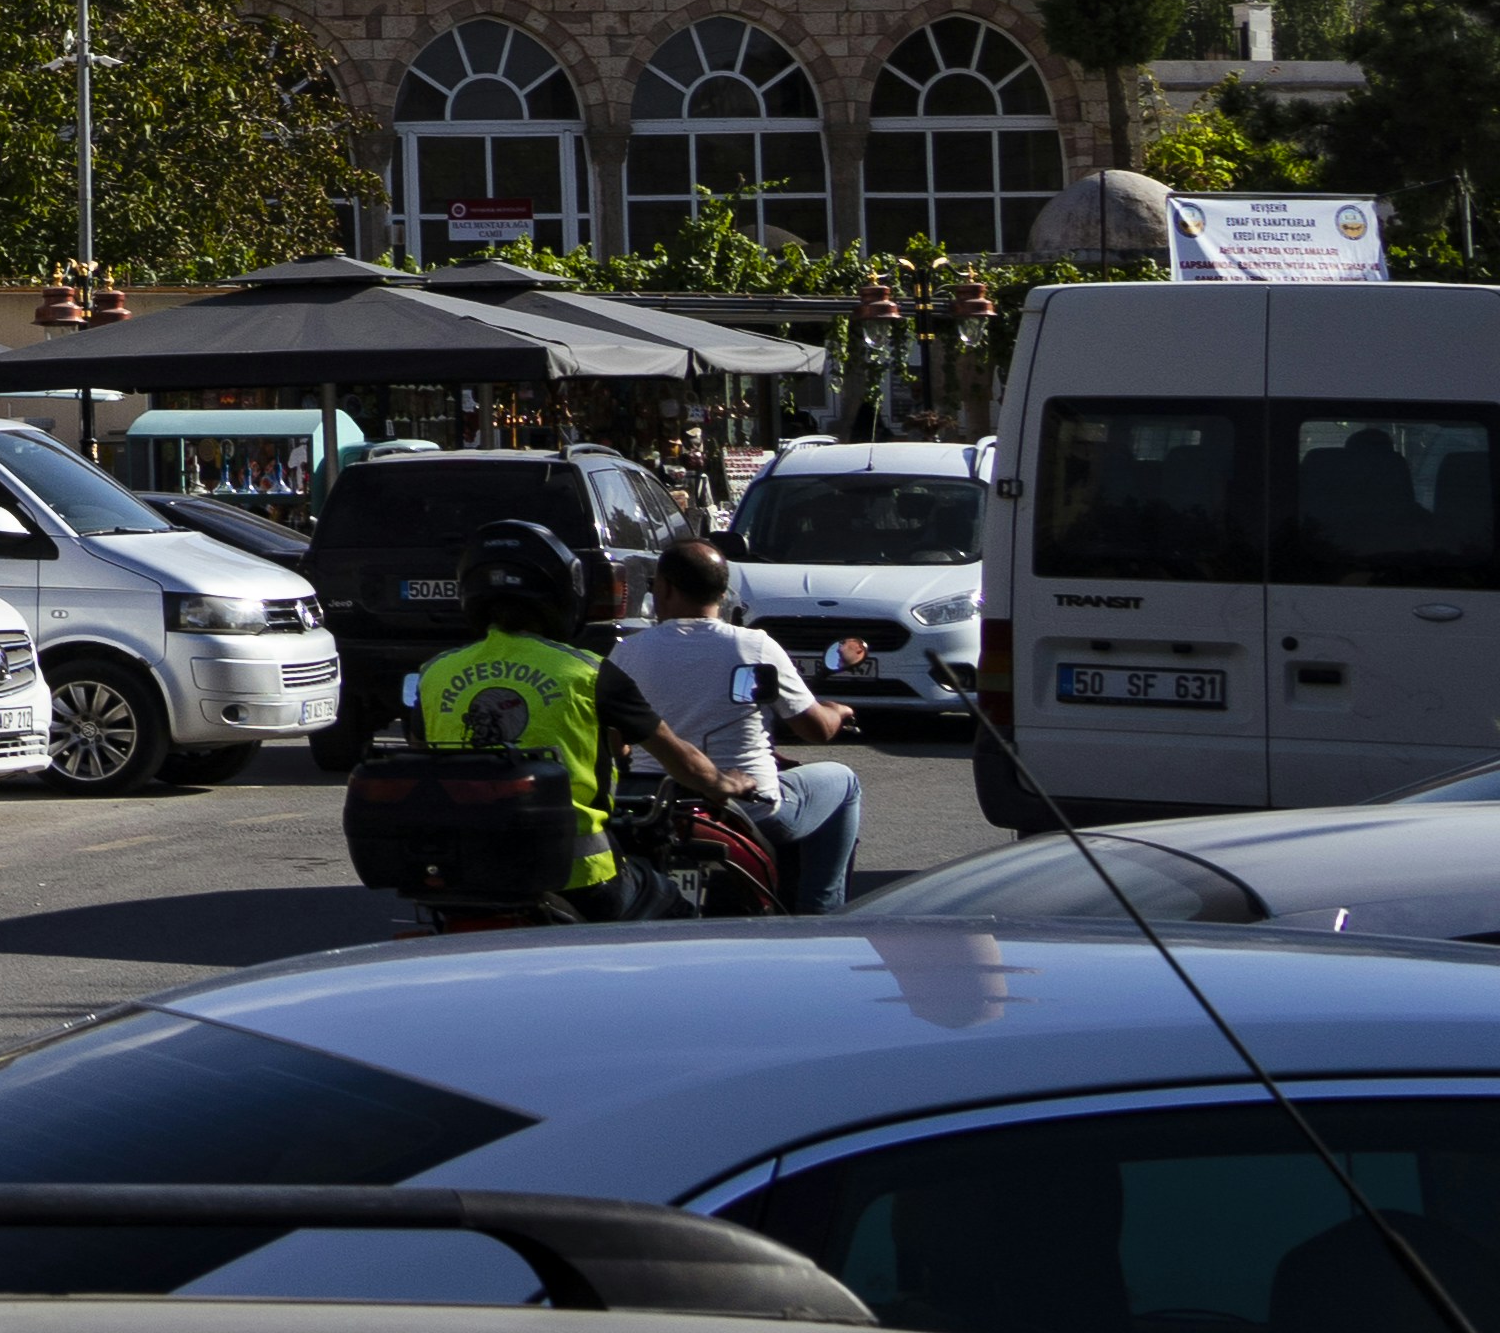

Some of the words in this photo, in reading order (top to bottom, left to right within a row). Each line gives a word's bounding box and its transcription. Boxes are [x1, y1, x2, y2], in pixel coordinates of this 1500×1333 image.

[1053, 593, 1145, 610] TRANSIT
[440, 660, 564, 713] PROFESYONEL
[1074, 671, 1104, 695] 50
[1127, 673, 1158, 697] SF
[1174, 675, 1217, 700] 631
